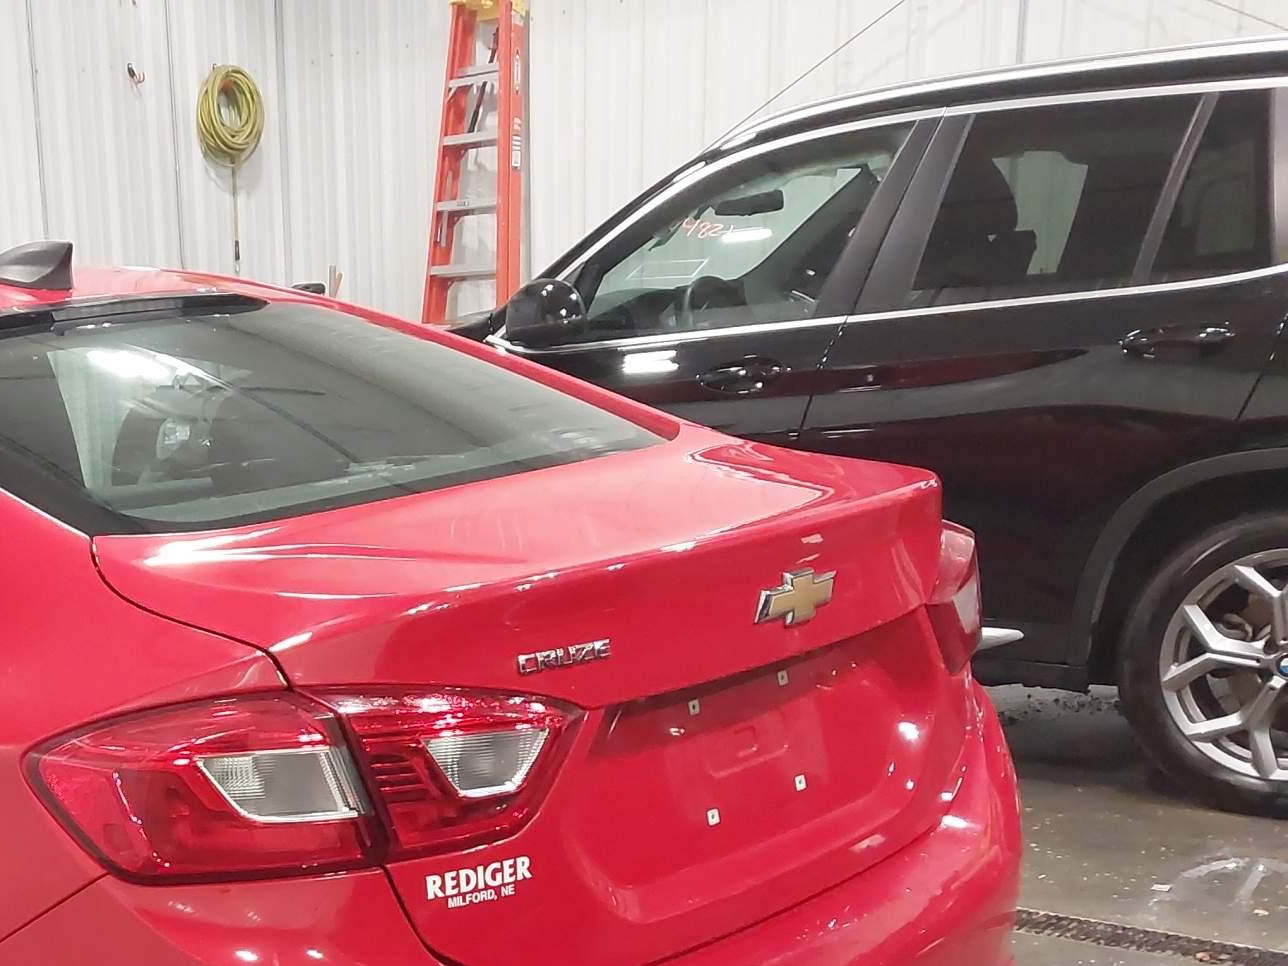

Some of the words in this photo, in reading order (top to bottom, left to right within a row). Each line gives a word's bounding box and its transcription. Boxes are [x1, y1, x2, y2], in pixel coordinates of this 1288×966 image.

[518, 638, 611, 673] CRUZE
[425, 856, 532, 899] REDIGER
[447, 889, 497, 908] MILFORD,
[501, 884, 515, 896] NE
